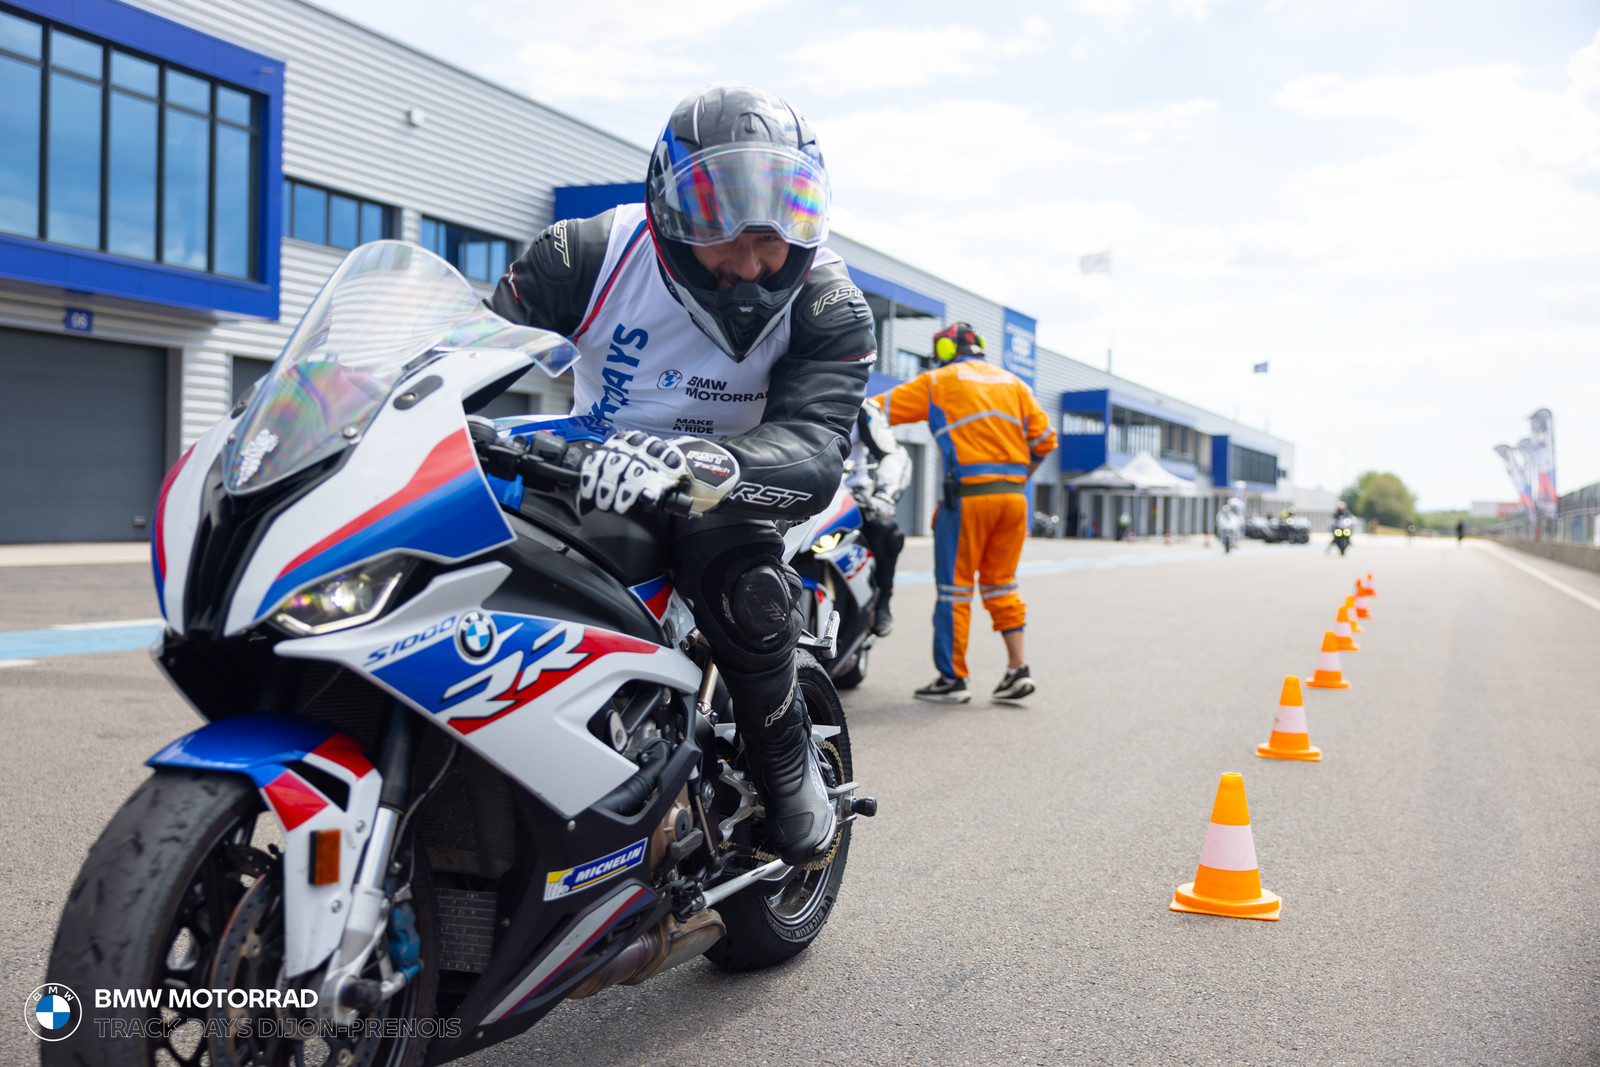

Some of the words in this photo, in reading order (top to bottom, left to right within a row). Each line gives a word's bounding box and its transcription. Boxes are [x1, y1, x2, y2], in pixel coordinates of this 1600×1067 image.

[687, 376, 728, 391] BMW
[675, 418, 714, 426] MAKE
[685, 426, 714, 434] RIDE
[686, 450, 728, 465] RST
[729, 481, 813, 508] RST
[575, 846, 642, 882] MICHELIN
